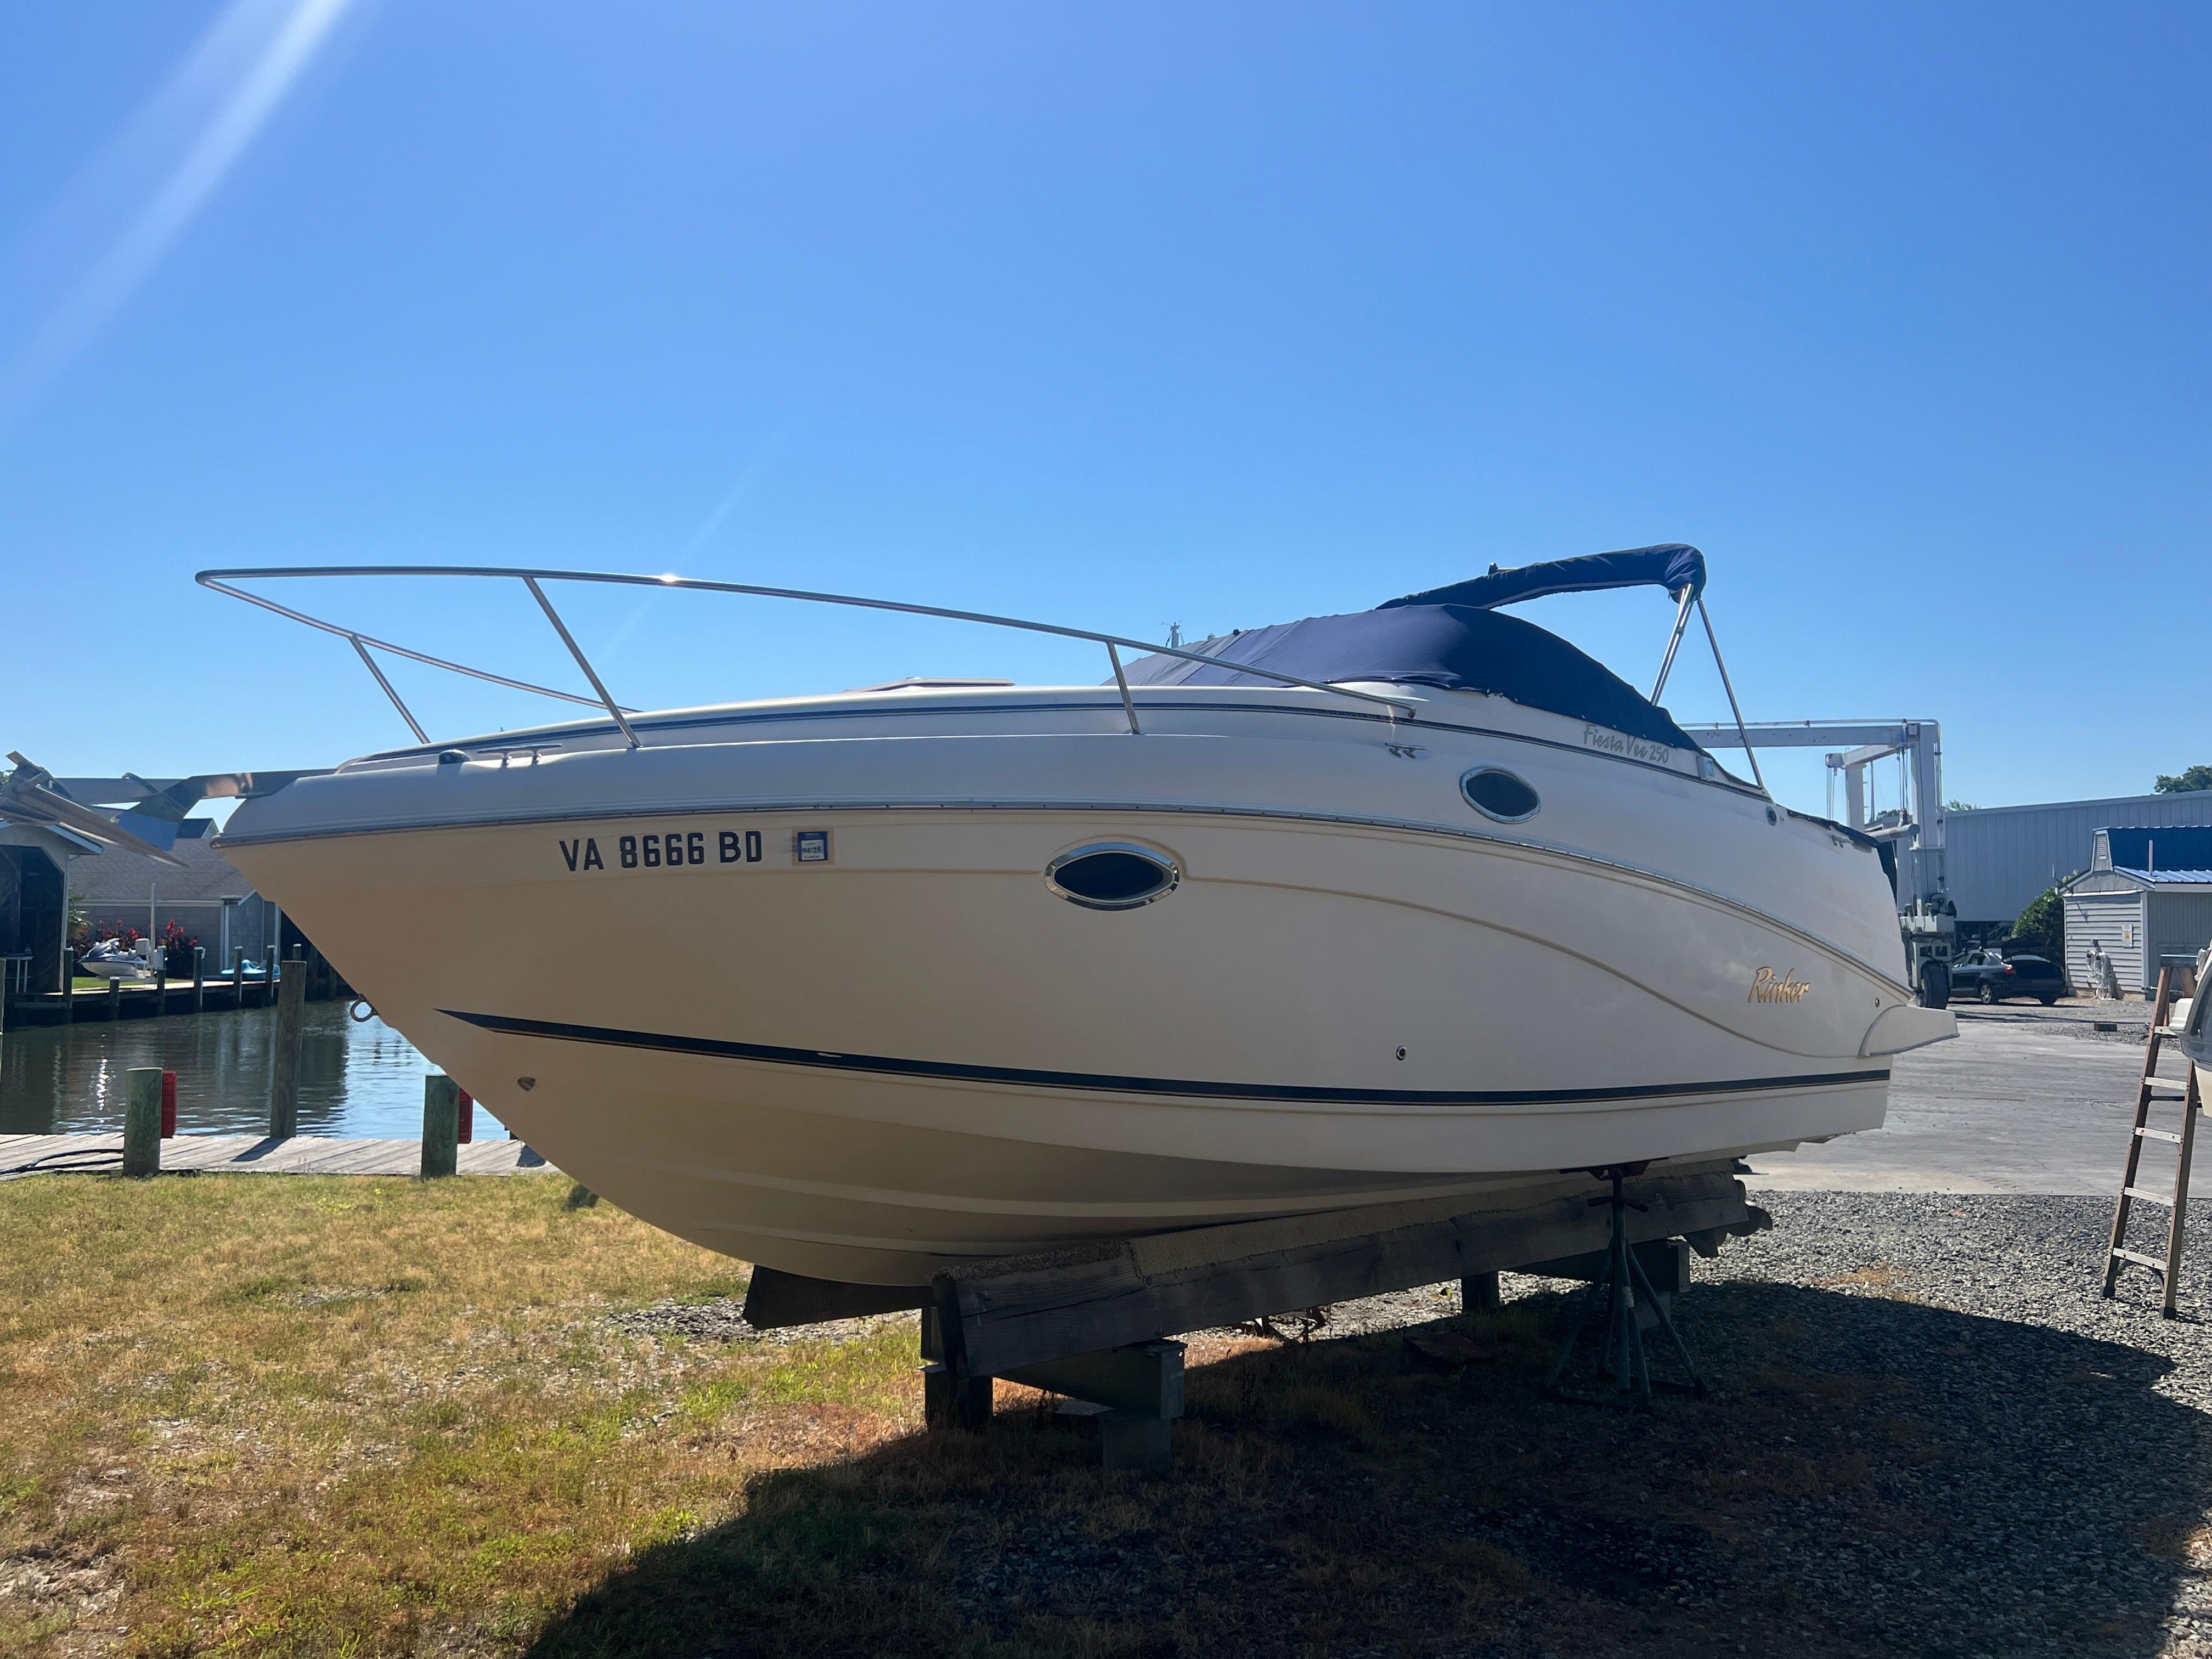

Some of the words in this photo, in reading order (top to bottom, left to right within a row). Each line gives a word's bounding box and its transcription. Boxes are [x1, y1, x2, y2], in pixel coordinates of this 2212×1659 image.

[1583, 724, 1624, 753] Fiesta
[1627, 735, 1648, 759] Vee
[1650, 744, 1669, 764] 250
[559, 838, 605, 871] VA
[619, 832, 705, 868] 8666
[719, 831, 762, 863] BD
[1747, 966, 1810, 1003] Rinker
